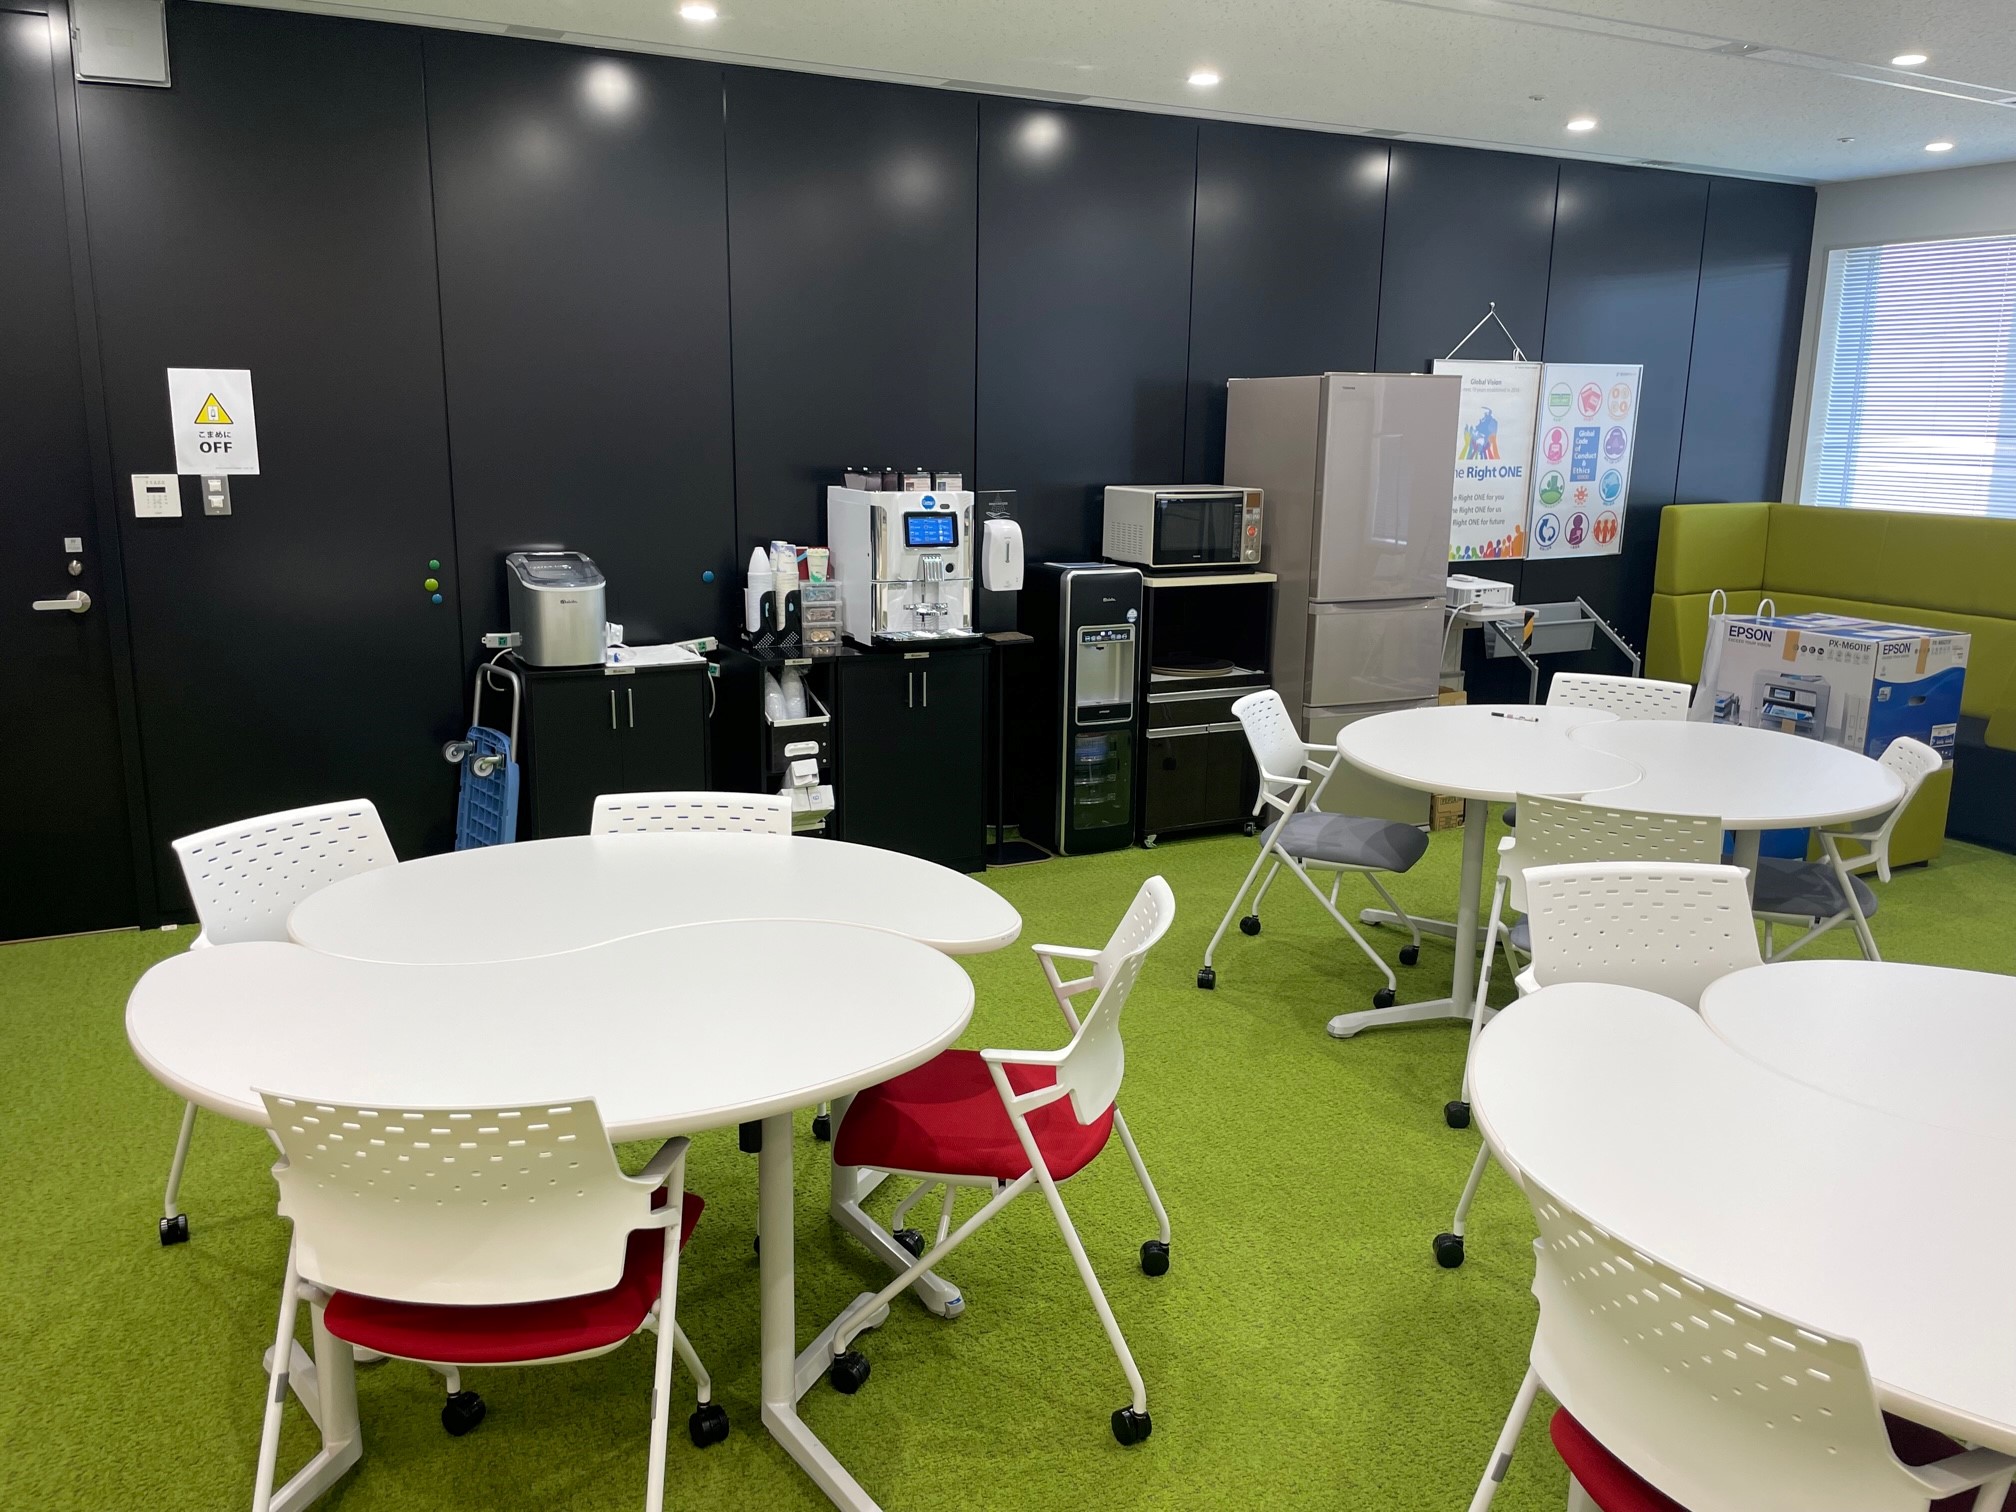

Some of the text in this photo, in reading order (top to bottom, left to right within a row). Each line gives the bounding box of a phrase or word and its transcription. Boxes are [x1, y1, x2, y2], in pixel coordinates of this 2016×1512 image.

[198, 430, 231, 438] こまめに
[199, 441, 233, 453] OFF
[1466, 466, 1497, 481] Right
[1499, 466, 1522, 478] ONE
[1458, 494, 1473, 503] Right
[1459, 506, 1474, 515] Right
[1453, 518, 1467, 527] Right
[1468, 518, 1480, 526] ONE
[1728, 625, 1773, 642] EPSON
[1828, 639, 1872, 653] PX-M6011F
[1882, 643, 1912, 655] EPSON
